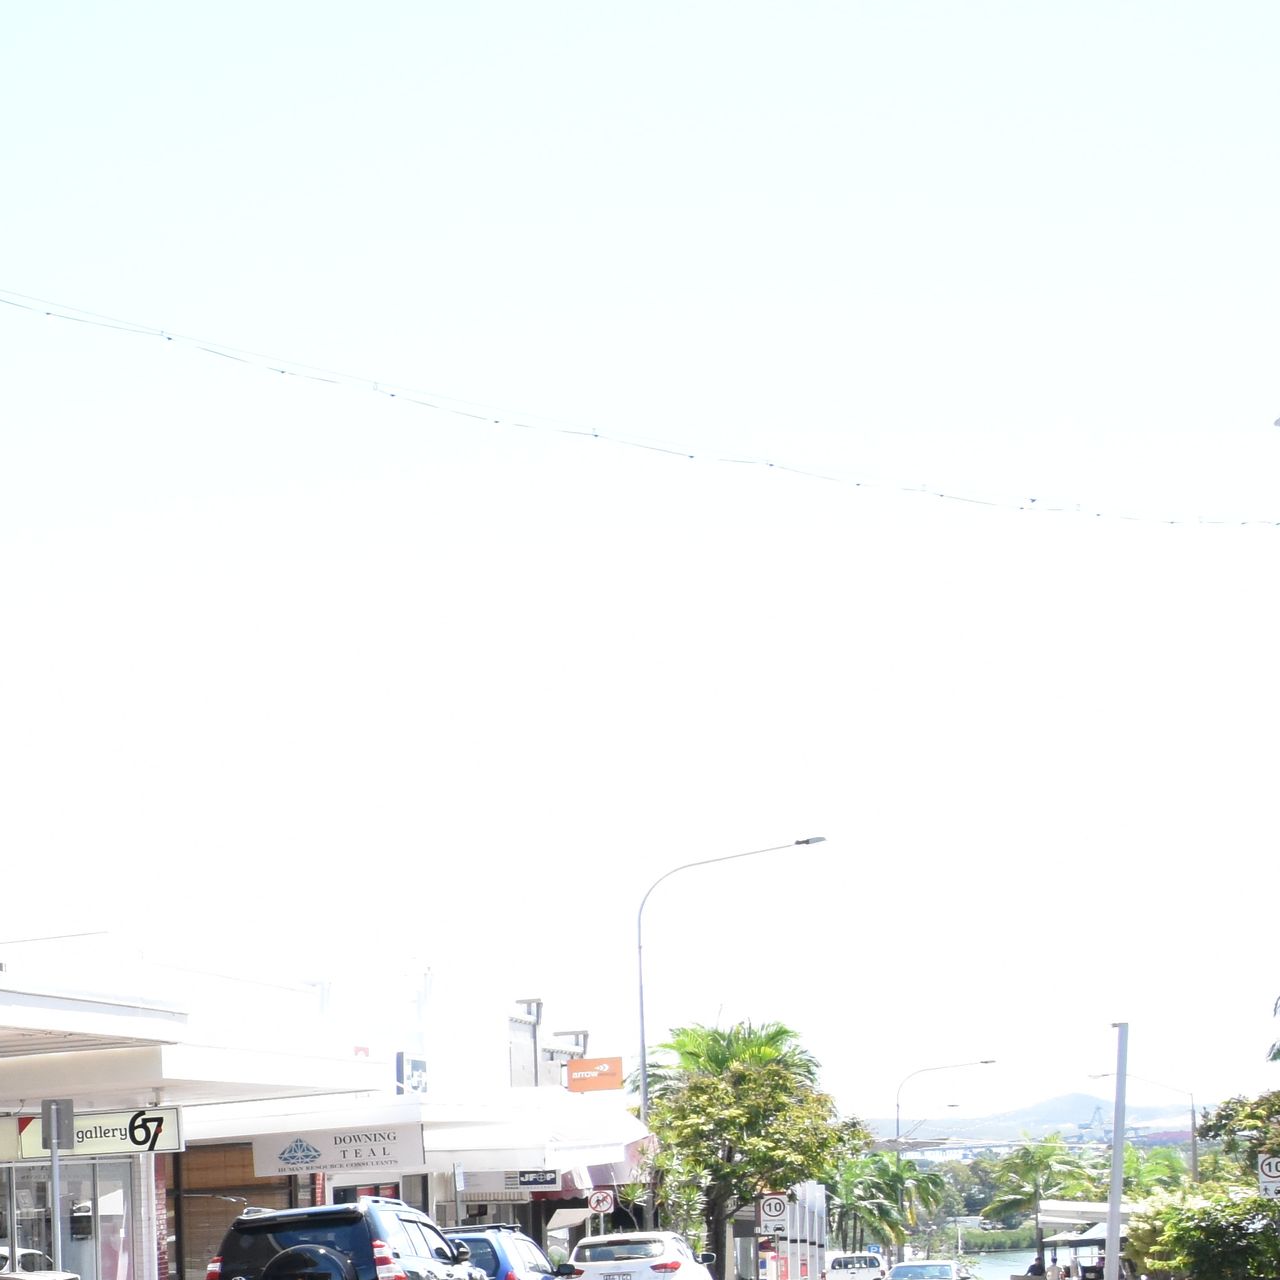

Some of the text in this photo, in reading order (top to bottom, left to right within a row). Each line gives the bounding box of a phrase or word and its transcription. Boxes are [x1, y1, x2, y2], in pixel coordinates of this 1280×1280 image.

[334, 1131, 397, 1146] DOWNING
[340, 1147, 391, 1159] TEAL
[306, 1163, 344, 1171] RESOURCE
[345, 1160, 399, 1169] CONSULTANTS
[766, 1202, 781, 1212] 10
